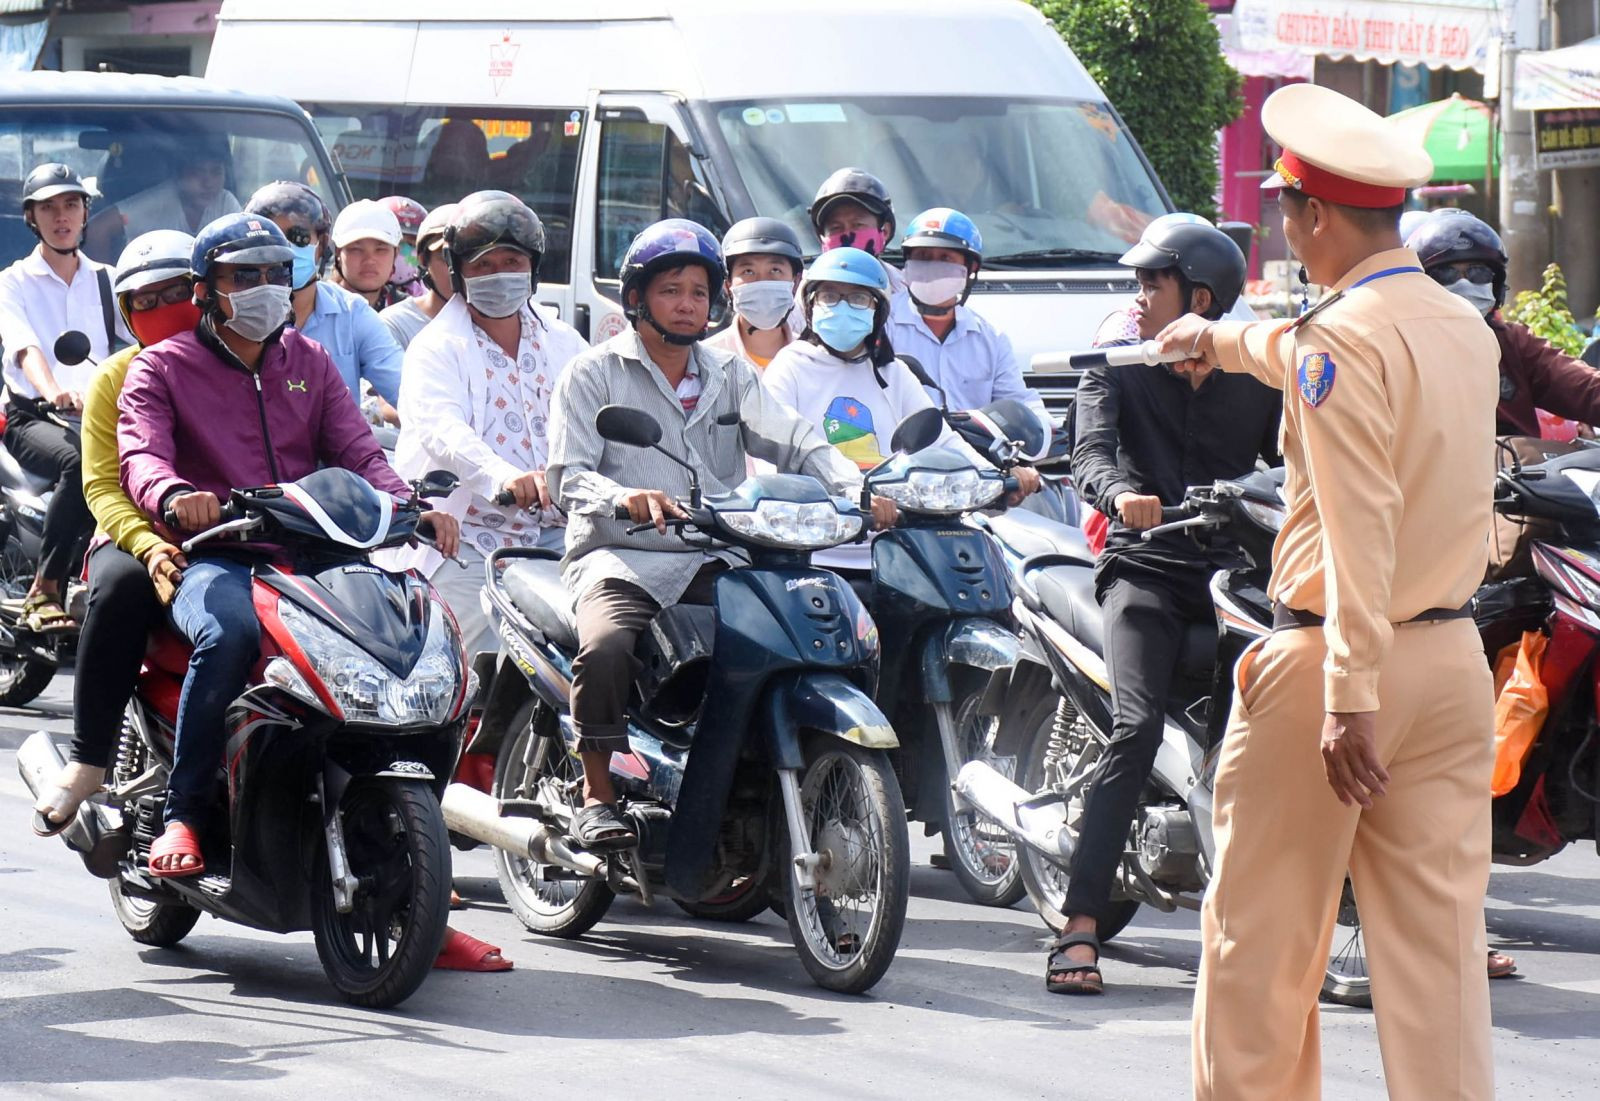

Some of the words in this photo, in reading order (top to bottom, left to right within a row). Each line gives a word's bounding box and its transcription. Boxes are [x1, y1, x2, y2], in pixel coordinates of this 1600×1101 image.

[1276, 8, 1329, 45] CHUYÊN
[1331, 10, 1359, 48] BÁN
[1439, 26, 1469, 60] HEO
[344, 566, 382, 574] HONDA
